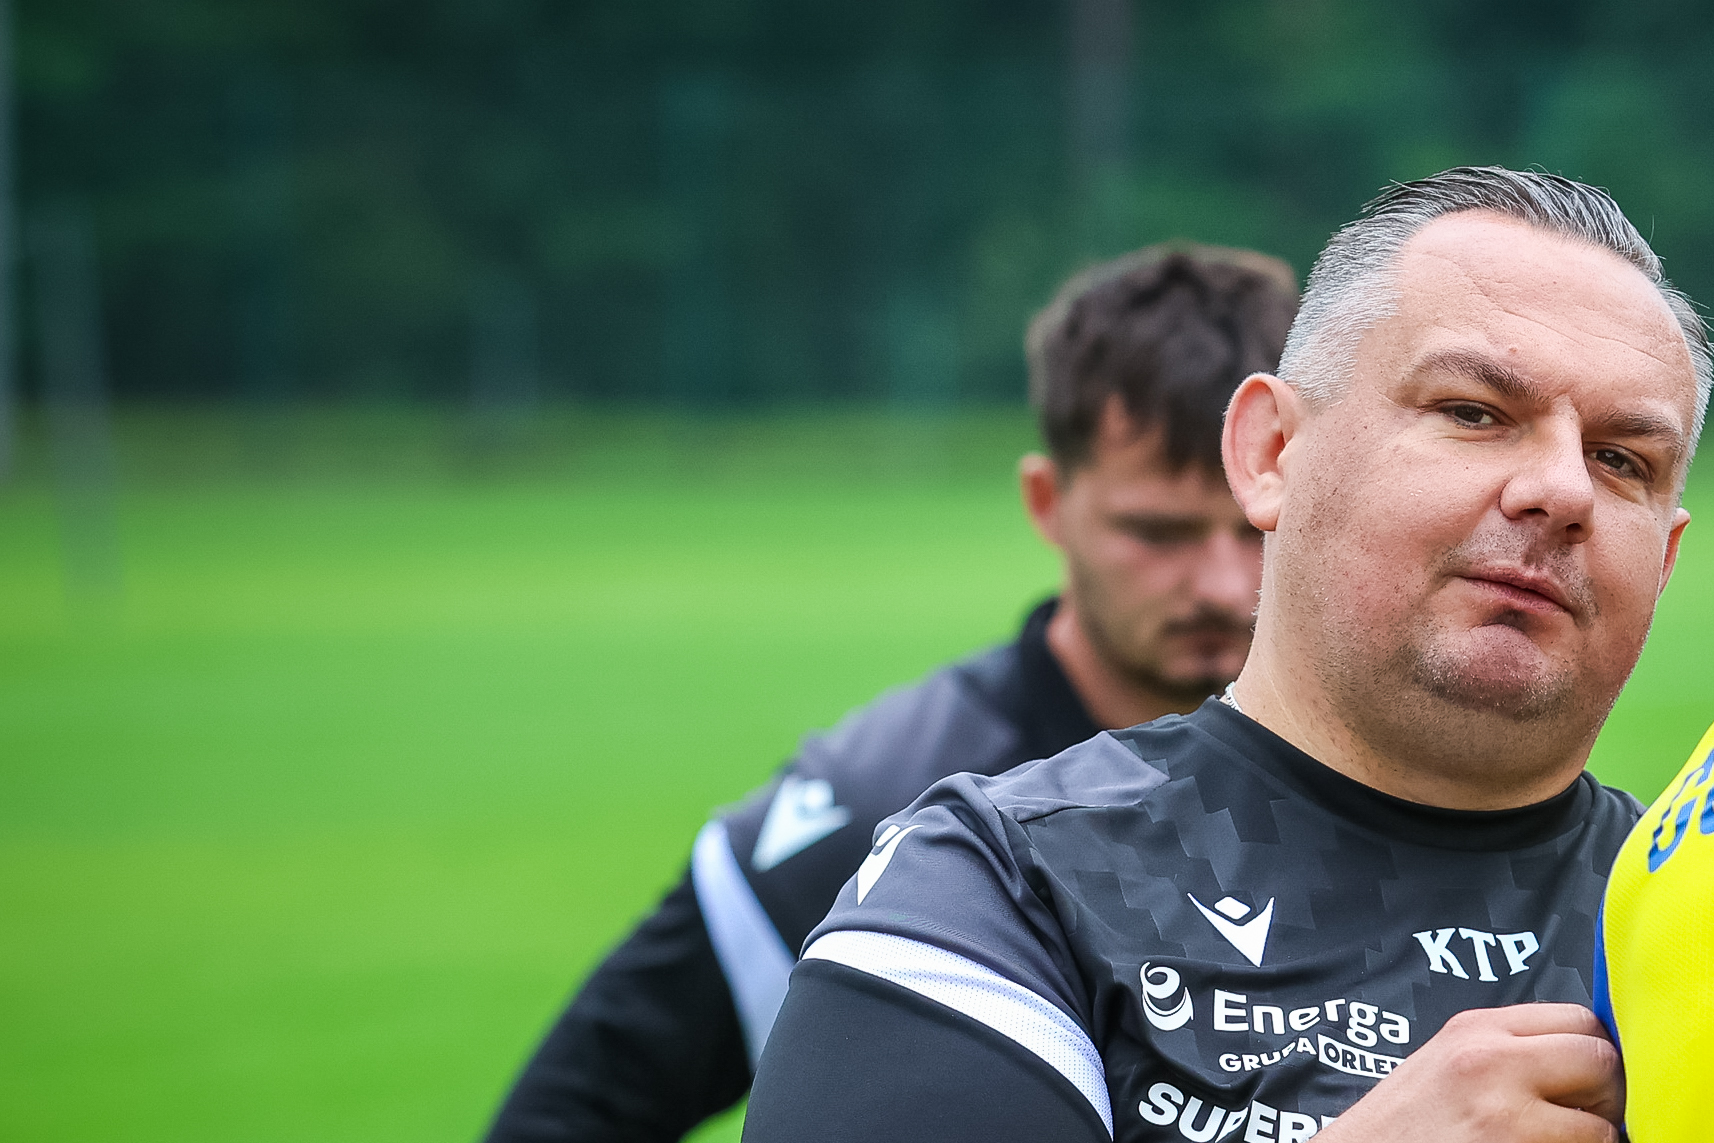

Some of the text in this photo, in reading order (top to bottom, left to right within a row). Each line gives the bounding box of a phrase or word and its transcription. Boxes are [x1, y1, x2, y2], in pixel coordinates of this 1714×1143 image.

[1412, 927, 1540, 982] KTP
[1213, 989, 1411, 1047] Energa
[1219, 1038, 1317, 1072] GRUPA
